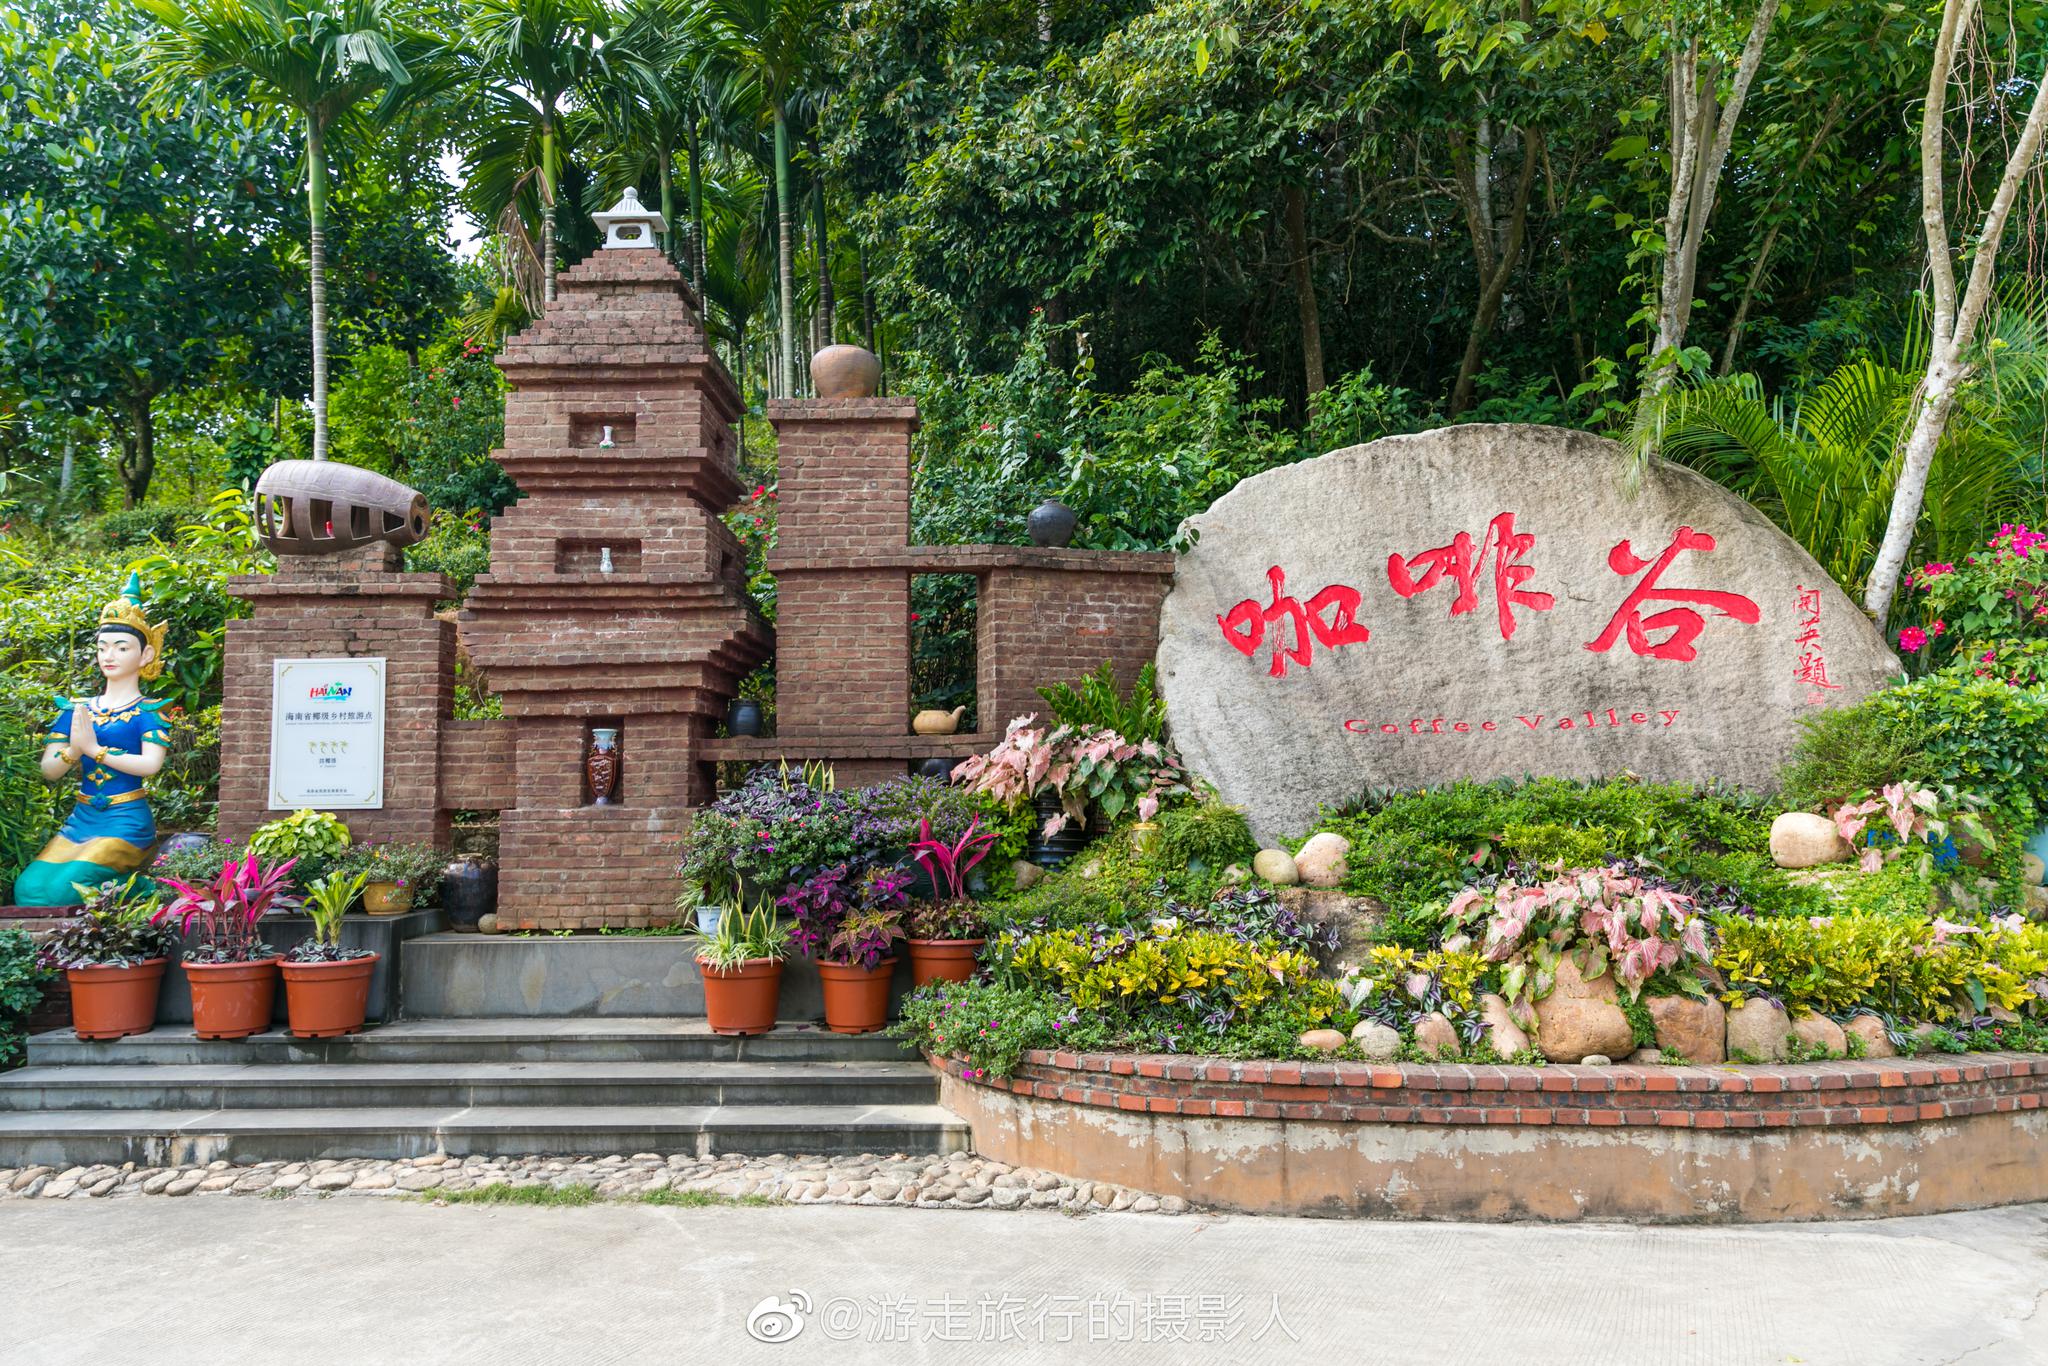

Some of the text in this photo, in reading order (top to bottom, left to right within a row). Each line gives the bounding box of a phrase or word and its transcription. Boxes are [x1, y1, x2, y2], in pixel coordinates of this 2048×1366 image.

[1215, 511, 1761, 679] 咖啡谷
[1343, 706, 1681, 735] Coffee Valley
